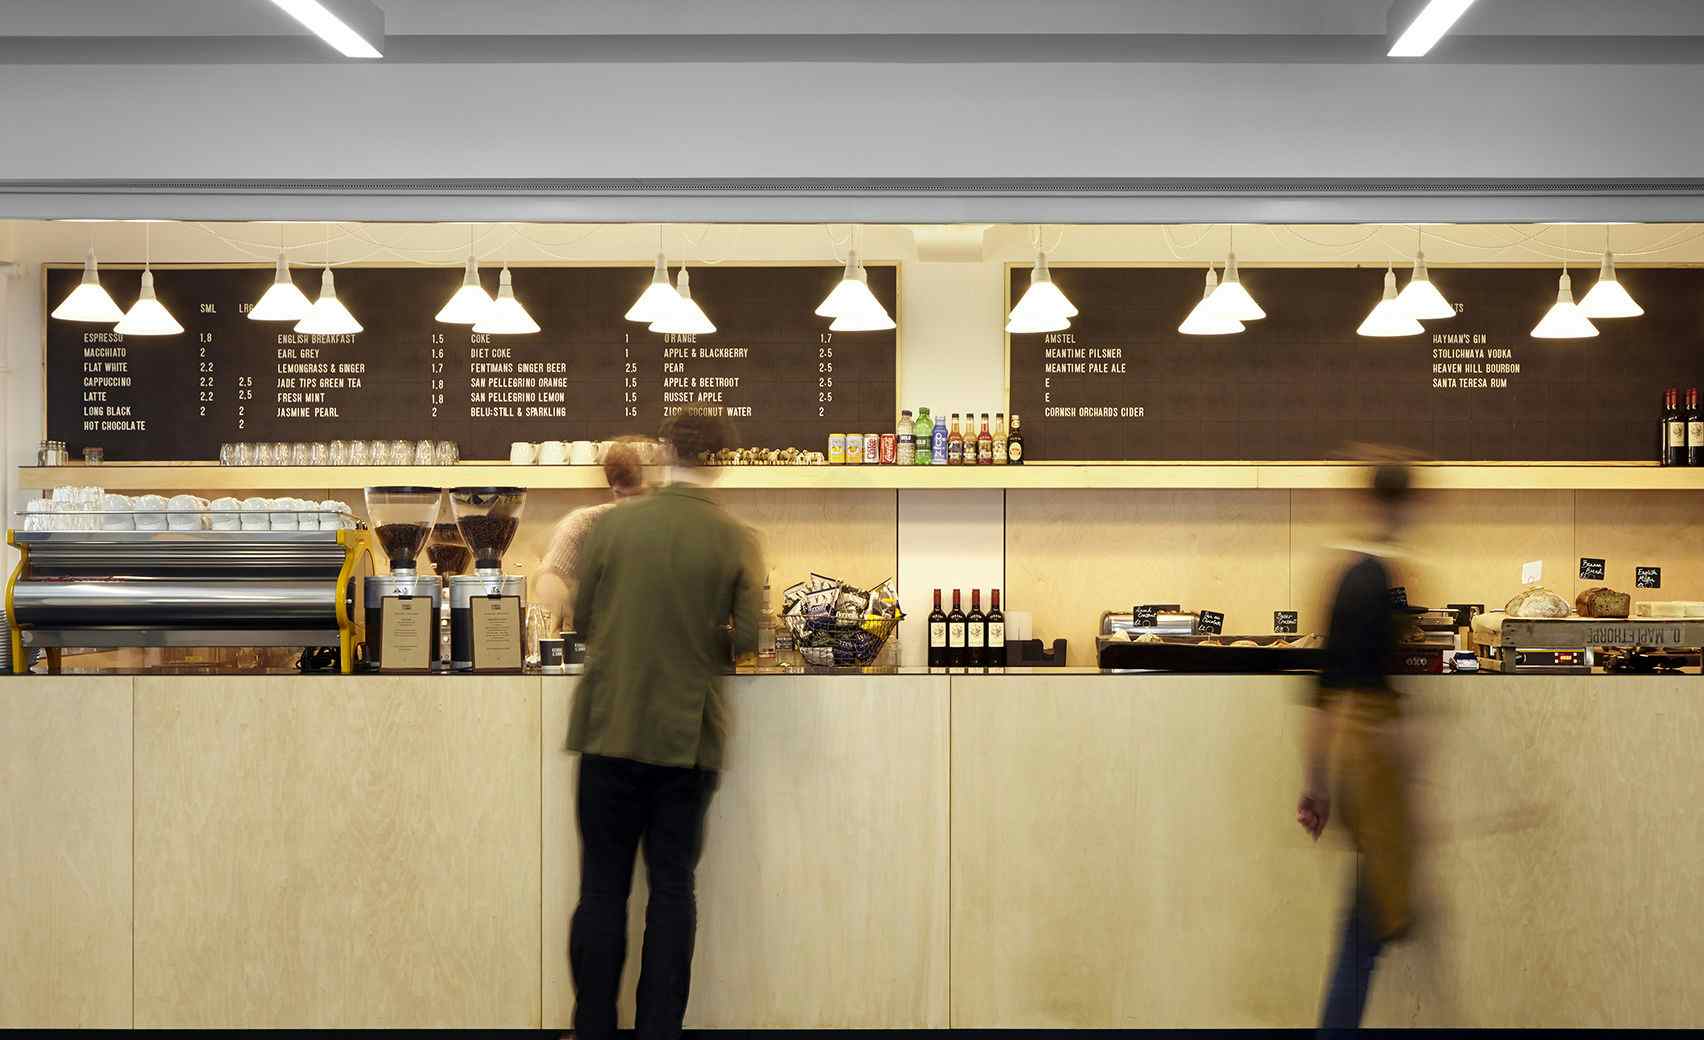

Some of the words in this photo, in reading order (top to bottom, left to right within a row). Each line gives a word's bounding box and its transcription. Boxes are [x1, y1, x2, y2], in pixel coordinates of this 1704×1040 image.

[201, 304, 216, 313] SML
[200, 333, 212, 343] 1.8
[278, 335, 308, 343] ENGLISH
[432, 334, 444, 343] 1.5
[471, 335, 490, 343] COKE
[821, 333, 832, 344] 1.7
[1045, 334, 1076, 343] AMSTEL
[1433, 334, 1470, 344] HAYMAN'S
[1473, 334, 1486, 344] GIN
[84, 348, 126, 357] MACCHIATO
[200, 348, 205, 357] 2
[278, 349, 297, 358] EARL
[301, 349, 319, 358] GREY
[432, 349, 443, 358] 1.6
[471, 348, 489, 358] DIET
[492, 348, 511, 358] COKE
[664, 348, 688, 358] APPLE
[692, 348, 696, 357] &
[700, 348, 748, 358] BLACKBERRY
[819, 348, 832, 358] 2.5
[1046, 349, 1085, 358] MEANTIME
[1089, 349, 1121, 358] PILSNER
[1433, 349, 1484, 359] STOLICHNAYA
[1488, 349, 1511, 358] VODKA
[84, 362, 102, 372] FLAT
[105, 362, 127, 372] WHITE
[201, 362, 213, 372] 2.2
[278, 364, 328, 373] LEMONGRASS
[331, 364, 335, 373] &
[339, 364, 365, 373] GINGER
[432, 363, 443, 374] 1.7
[518, 363, 543, 372] GINGER
[547, 363, 566, 372] BEER
[626, 363, 637, 372] 2.5
[664, 363, 684, 372] PEAR
[1046, 363, 1087, 373] MEANTIME
[1089, 363, 1108, 373] PALE
[1111, 363, 1125, 373] ALE
[1433, 364, 1462, 373] HEAVEN
[1465, 364, 1482, 373] HILL
[1486, 364, 1520, 373] BOURBON
[84, 377, 131, 386] CAPPUCCINO
[200, 377, 213, 386] 2.2
[239, 377, 253, 387] 2.5
[277, 378, 295, 388] JADE
[299, 378, 316, 388] TIPS
[320, 378, 344, 388] GREEN
[348, 378, 361, 388] TEA
[432, 380, 443, 389] 1.8
[471, 378, 485, 387] SAN
[489, 378, 535, 387] PELLEGRINO
[539, 378, 567, 387] ORANGE
[626, 378, 637, 388] 1.5
[664, 377, 688, 387] APPLE
[691, 377, 696, 387] &
[700, 377, 739, 387] BEETROOT
[819, 378, 832, 387] 2.5
[1045, 378, 1050, 387] E
[1433, 378, 1456, 387] SANTA
[1459, 378, 1487, 387] TERESA
[1491, 378, 1506, 387] RUM
[84, 392, 106, 401] LATTE
[200, 392, 213, 401] 2.2
[239, 390, 252, 400] 2.5
[278, 393, 302, 402] FRESH
[305, 393, 325, 402] MINT
[432, 394, 443, 404] 1.8
[471, 393, 485, 402] SAN
[489, 392, 535, 402] PELLEGRINO
[539, 392, 564, 402] LEMON
[625, 392, 636, 402] 1.5
[664, 392, 694, 402] RUSSET
[698, 392, 722, 402] APPLE
[819, 392, 832, 401] 2.5
[1045, 393, 1049, 402] E
[84, 407, 103, 416] LONG
[107, 406, 131, 416] BLACK
[201, 407, 205, 416] 2
[239, 406, 244, 415] 2
[277, 408, 309, 417] JASMINE
[315, 408, 339, 417] PEARL
[432, 407, 437, 417] 2
[517, 407, 522, 416] &
[526, 407, 566, 416] SPARKLING
[625, 407, 637, 416] 1.5
[727, 407, 751, 416] WATER
[819, 407, 824, 416] 2
[1045, 407, 1076, 416] CORNISH
[1079, 407, 1118, 416] ORCHARDS
[1121, 407, 1144, 417] CIDER
[84, 421, 99, 430] HOT
[102, 421, 145, 430] CHOCOLATE
[239, 419, 244, 428] 2
